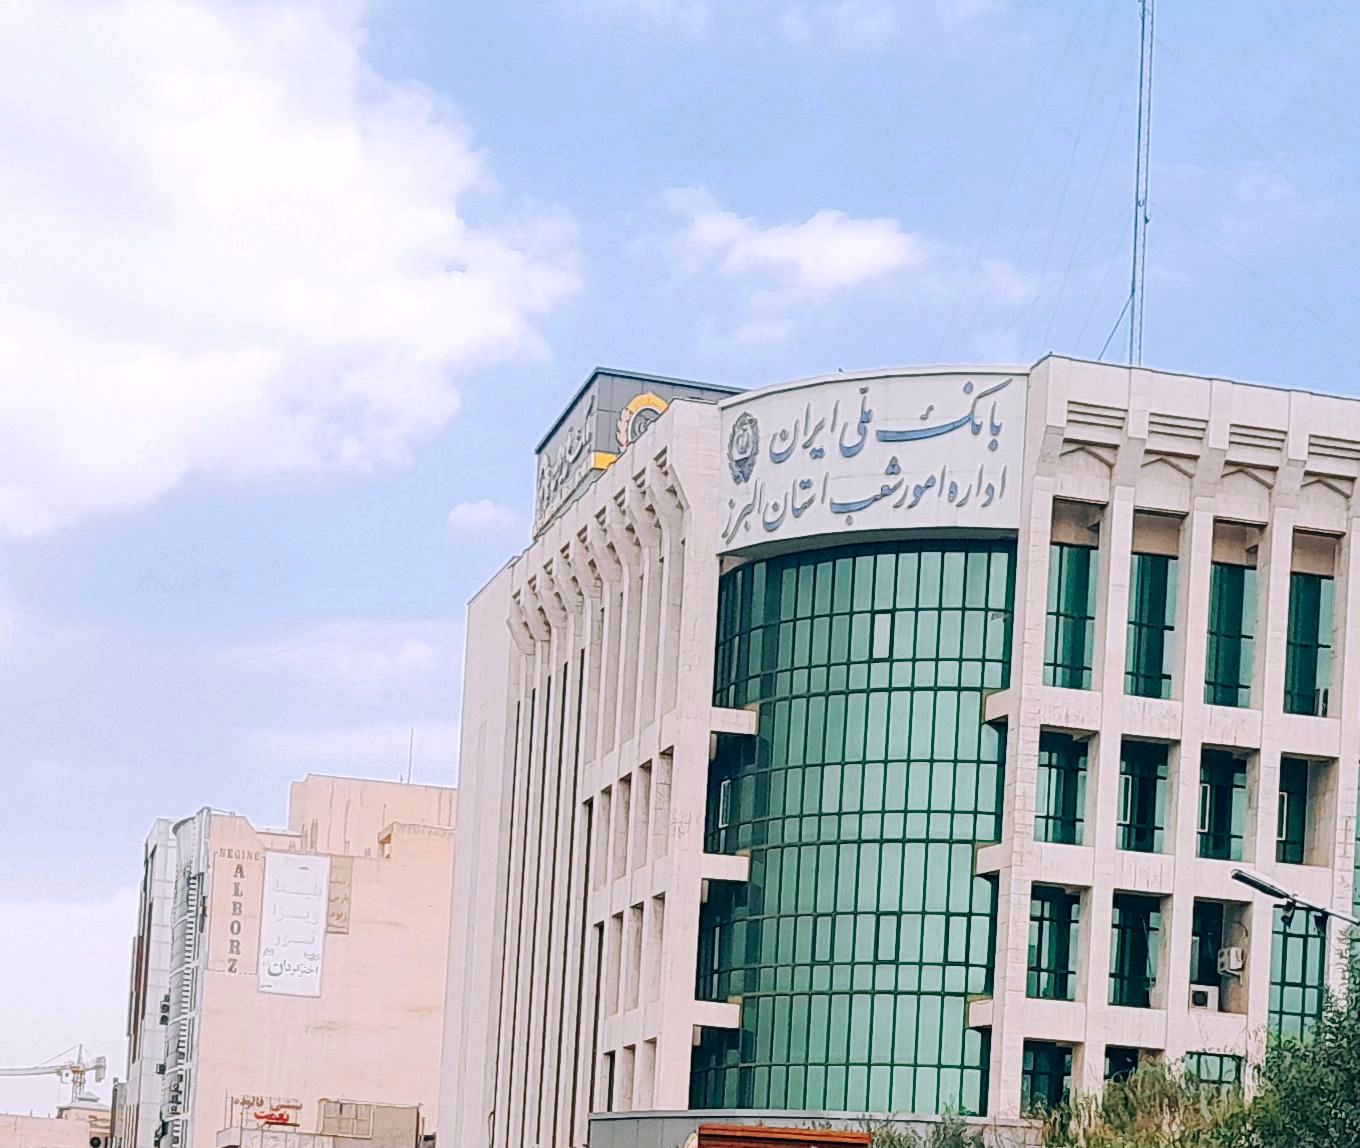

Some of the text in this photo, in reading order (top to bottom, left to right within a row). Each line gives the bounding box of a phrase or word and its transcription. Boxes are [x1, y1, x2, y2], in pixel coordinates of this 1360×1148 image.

[768, 399, 840, 464] ایران
[876, 378, 1013, 452] بانک
[721, 455, 1007, 546] اداره امور شعب استان البرز
[227, 862, 246, 974] ALBORZ
